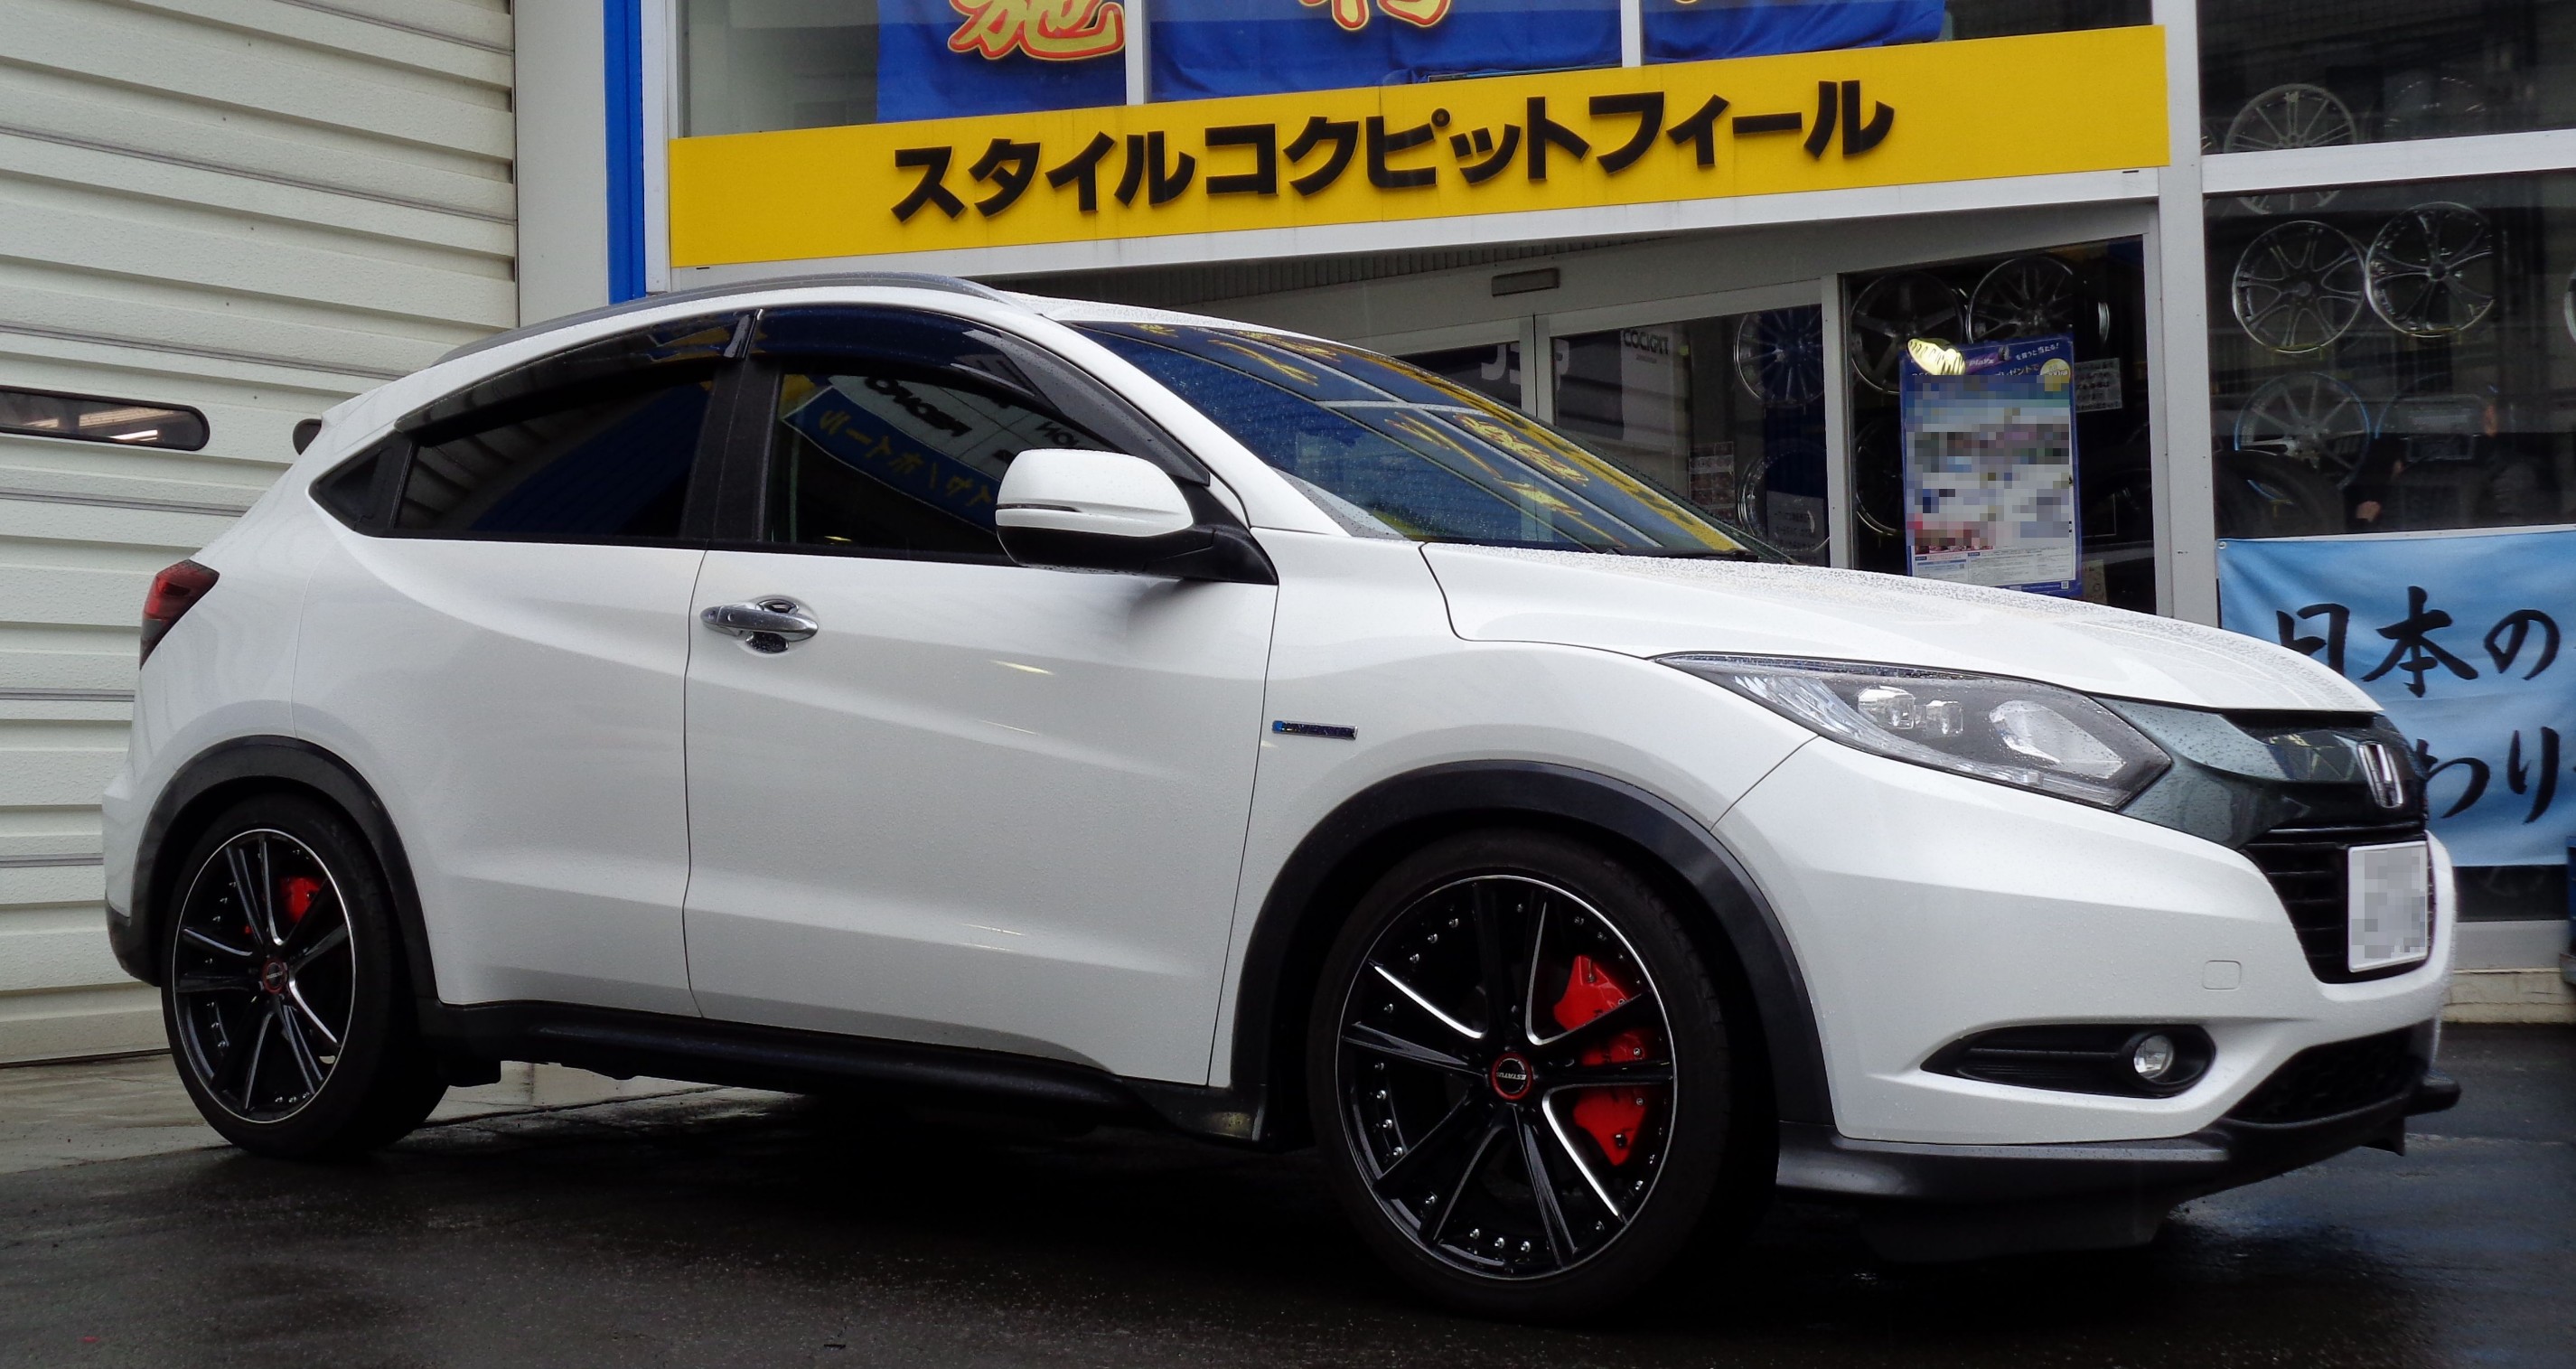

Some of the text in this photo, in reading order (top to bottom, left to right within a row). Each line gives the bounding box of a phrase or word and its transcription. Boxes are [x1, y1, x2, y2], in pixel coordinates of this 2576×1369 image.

[891, 80, 1896, 223] スタイルコクピットフィール
[2276, 585, 2561, 698] 日本の
